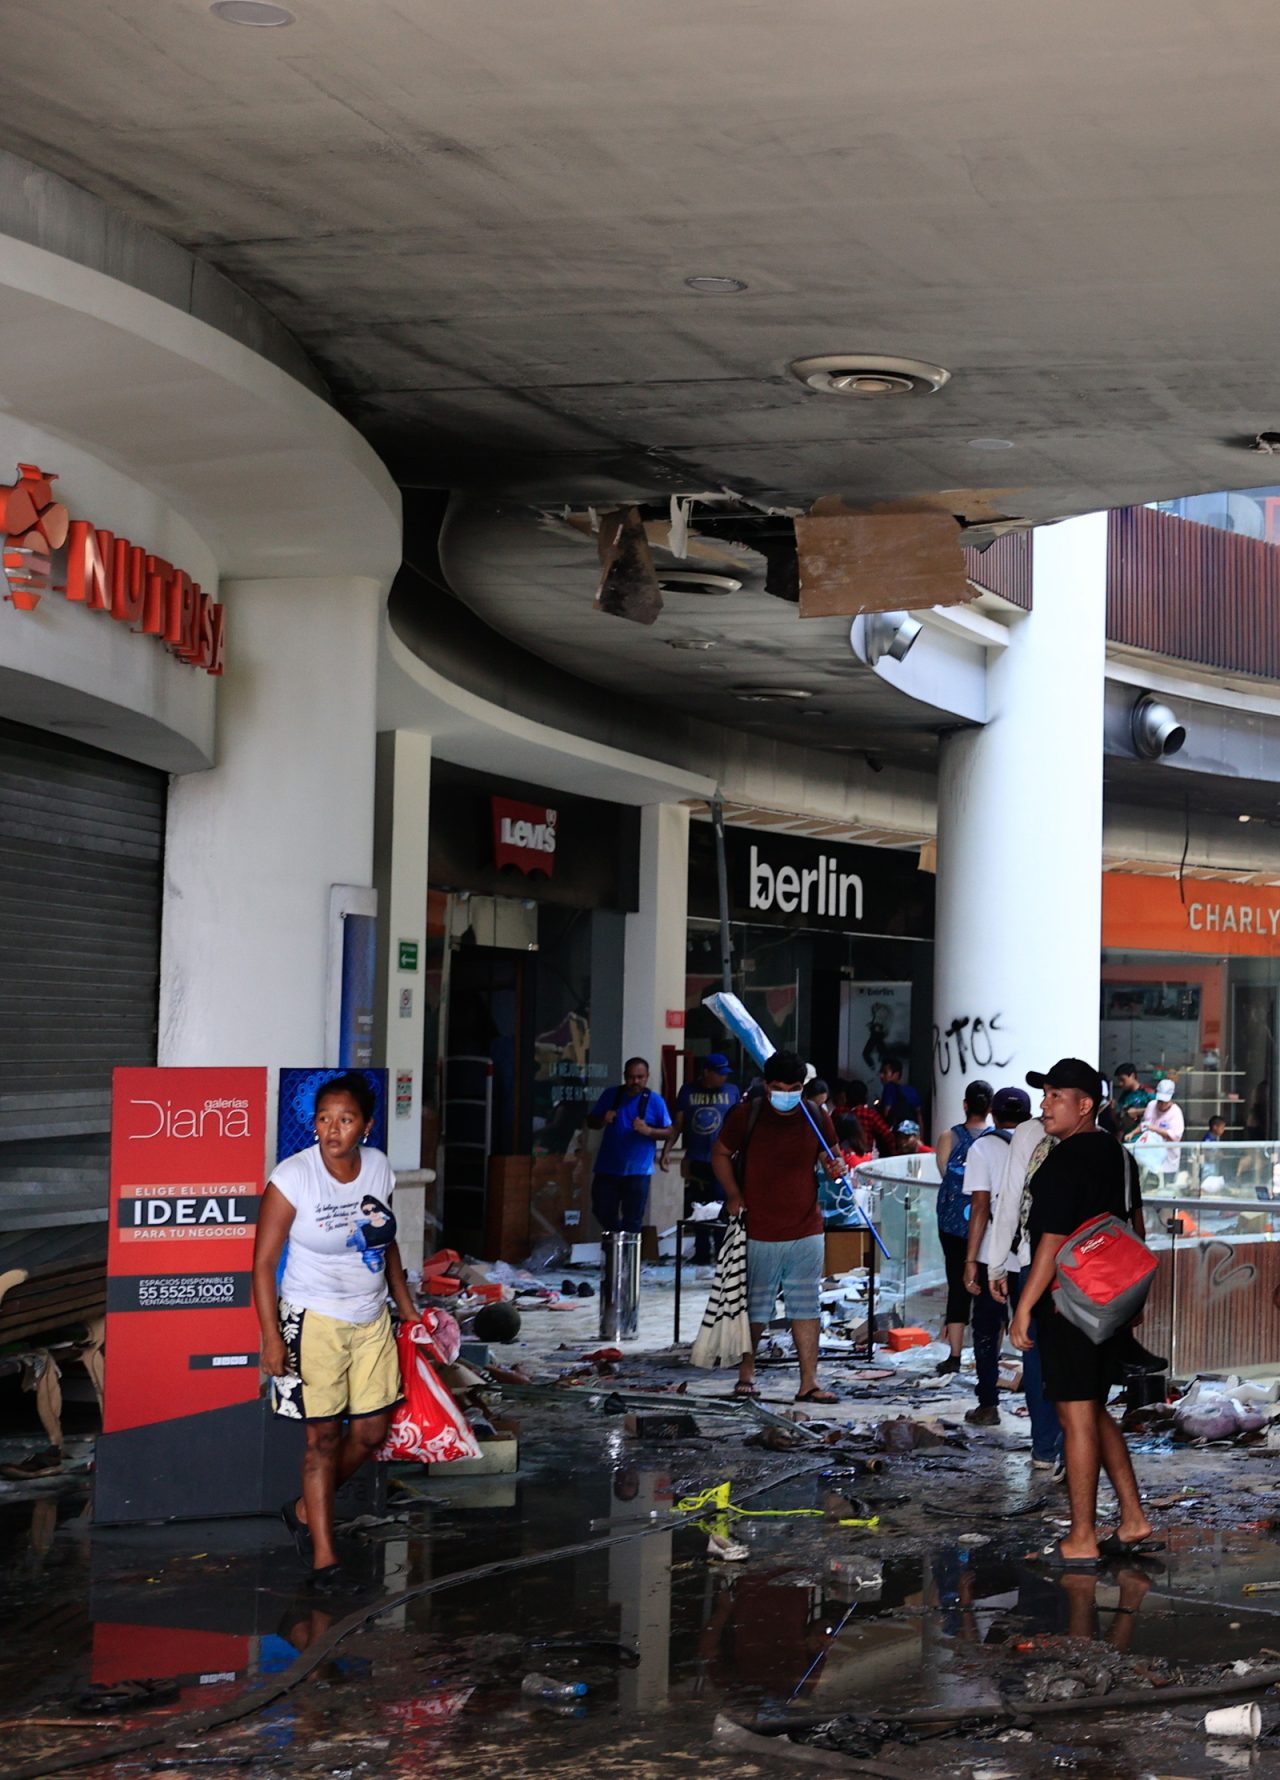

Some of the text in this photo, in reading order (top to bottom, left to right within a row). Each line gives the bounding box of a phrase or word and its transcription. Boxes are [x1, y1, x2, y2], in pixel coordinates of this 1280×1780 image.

[750, 845, 863, 920] berlin
[1189, 903, 1280, 936] CHARLY
[128, 1099, 251, 1139] Diana
[135, 1185, 247, 1197] ELIGE EL LUGAR
[134, 1198, 247, 1226] IDEAL
[134, 1227, 247, 1239] PARA TU NEGOCIO
[138, 1283, 235, 1300] 55 5525 1000
[139, 1276, 234, 1287] ESPACIOS DISPONIBLES
